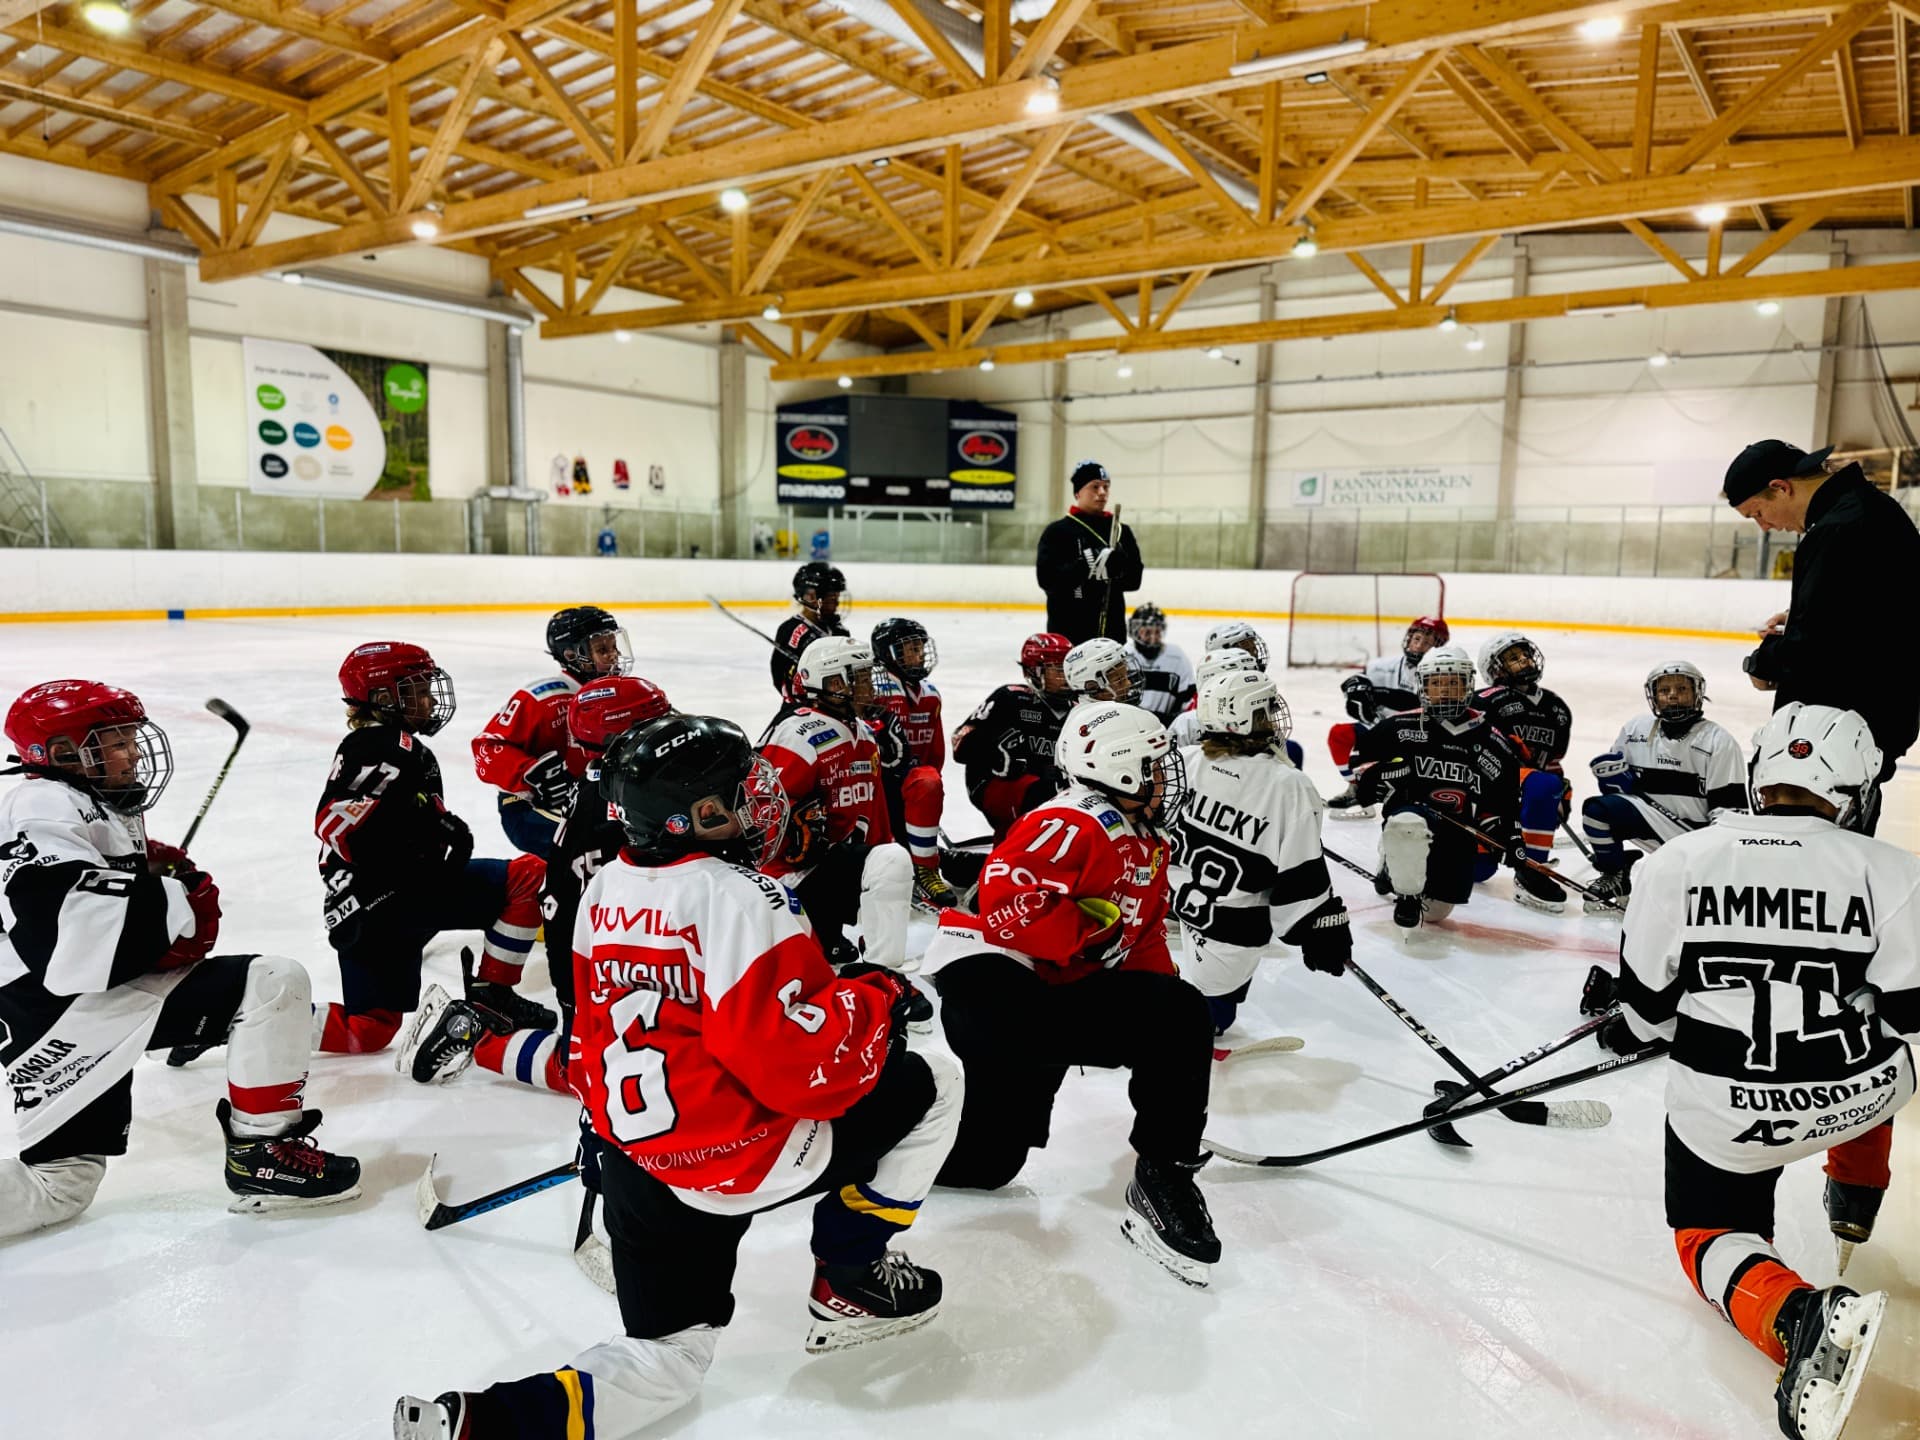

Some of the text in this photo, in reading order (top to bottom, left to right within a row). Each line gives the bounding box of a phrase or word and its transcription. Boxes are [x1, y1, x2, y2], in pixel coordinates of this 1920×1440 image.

[29, 684, 82, 701] CCM
[654, 728, 702, 759] CCM
[1111, 747, 1132, 757] CCM
[347, 762, 401, 796] 17
[1210, 765, 1241, 780] TACKLA
[1024, 817, 1081, 864] 71
[1738, 837, 1802, 848] TACKLA
[1686, 885, 1872, 937] TAMMELA
[777, 978, 827, 1034] 6
[1698, 956, 1871, 1072] 74
[1380, 993, 1444, 1051] CCM
[602, 988, 680, 1143] 6
[1597, 1053, 1639, 1073] BAUER
[1731, 1119, 1800, 1147] AC
[255, 1167, 275, 1180] 20
